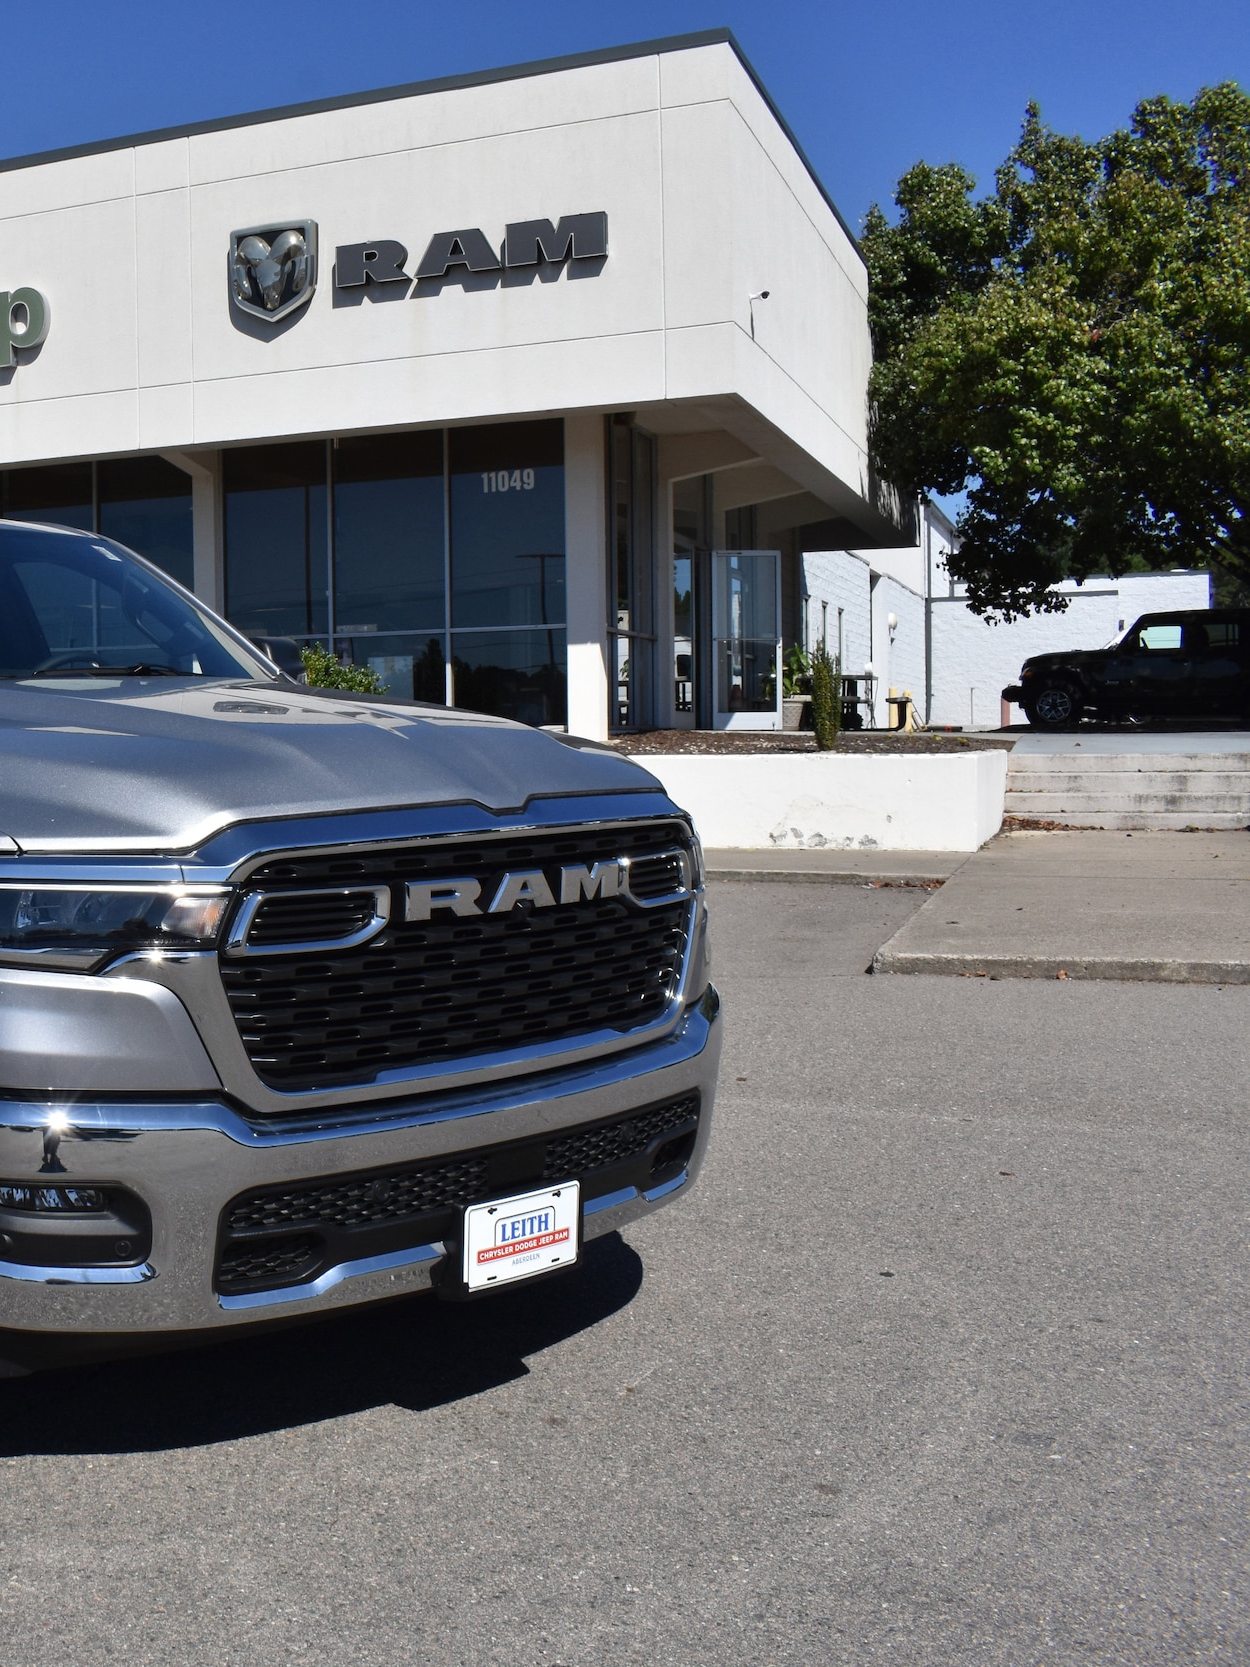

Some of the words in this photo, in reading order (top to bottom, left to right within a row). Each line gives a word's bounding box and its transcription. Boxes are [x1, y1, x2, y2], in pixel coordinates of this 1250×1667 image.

[335, 210, 609, 288] RAM
[481, 468, 535, 493] 11049
[405, 859, 623, 922] RAM
[500, 1212, 550, 1242] LEITH
[479, 1246, 514, 1261] CHRYSLER
[515, 1239, 538, 1252] DODGE
[538, 1235, 554, 1246] JEEP
[554, 1230, 568, 1241] RAM
[511, 1253, 541, 1266] ABERDEEN
